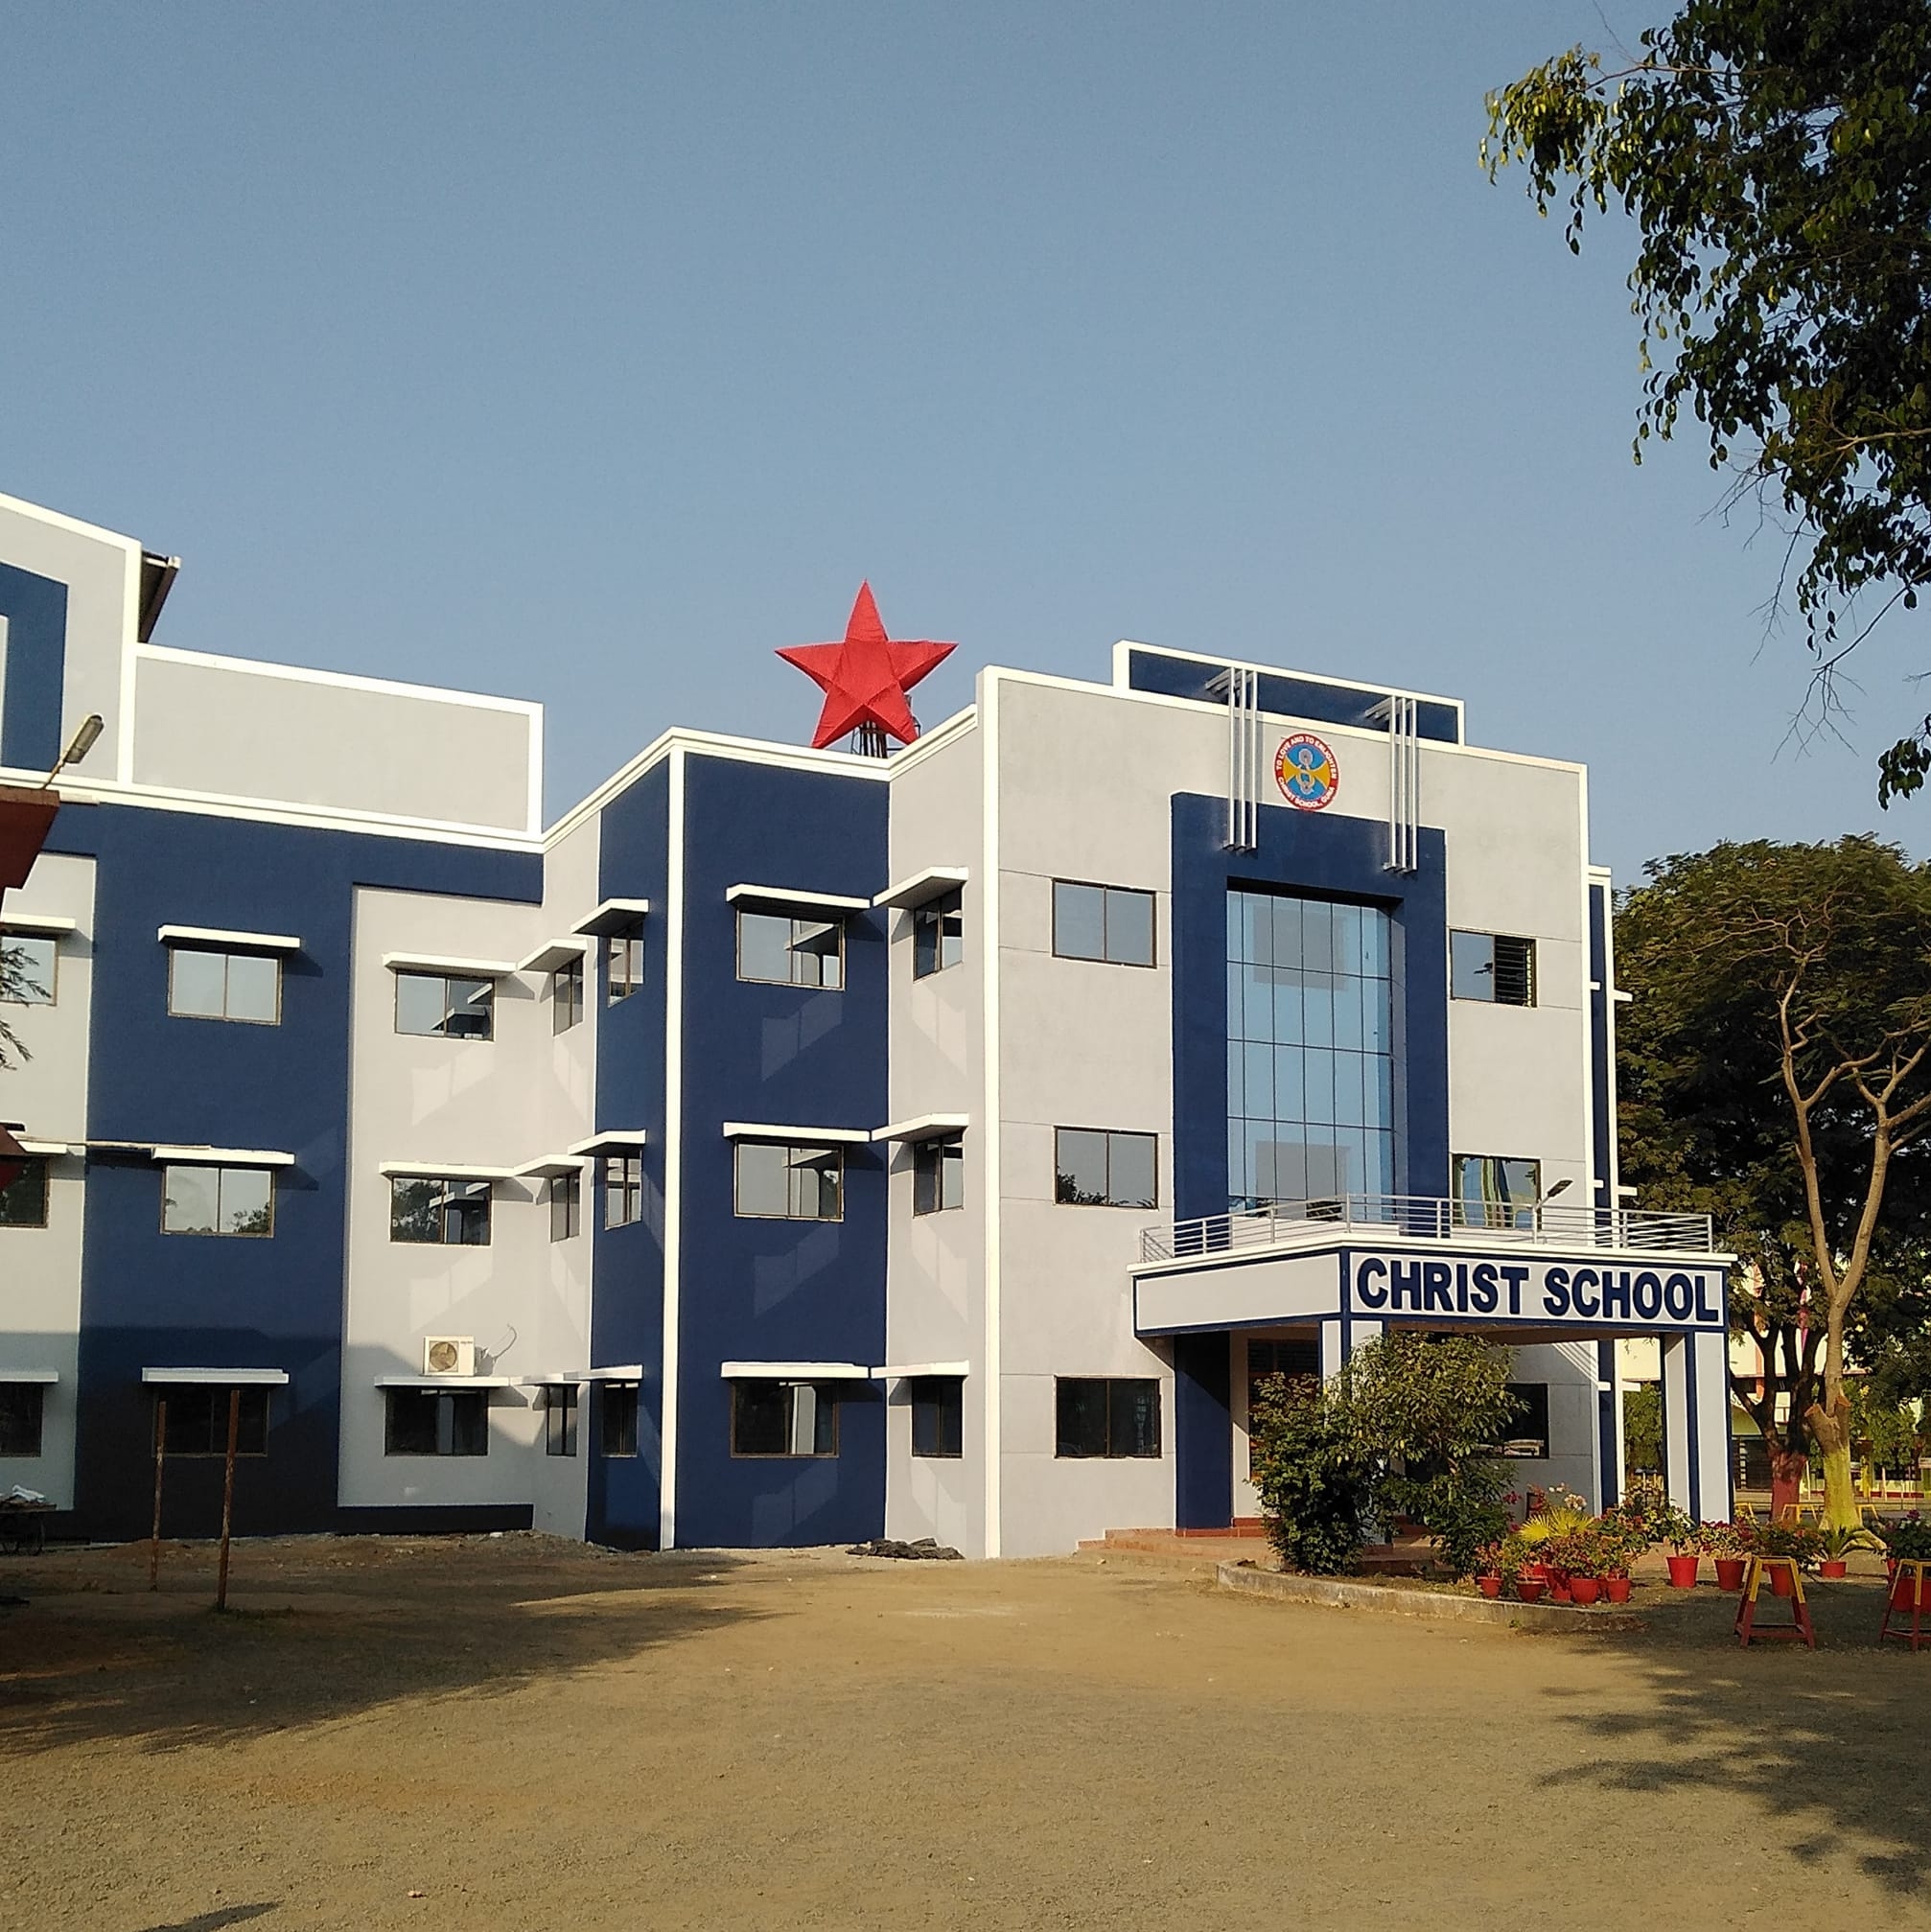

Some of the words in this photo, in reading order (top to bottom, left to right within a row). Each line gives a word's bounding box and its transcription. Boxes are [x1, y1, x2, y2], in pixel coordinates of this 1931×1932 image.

[1278, 742, 1291, 758] LOVE
[1314, 740, 1337, 779] ENLIGHTEN
[1276, 759, 1283, 771] TO
[1278, 777, 1295, 801] CHRIST
[1357, 1257, 1529, 1315] CHRIST
[1543, 1267, 1719, 1322] SCHOOL
